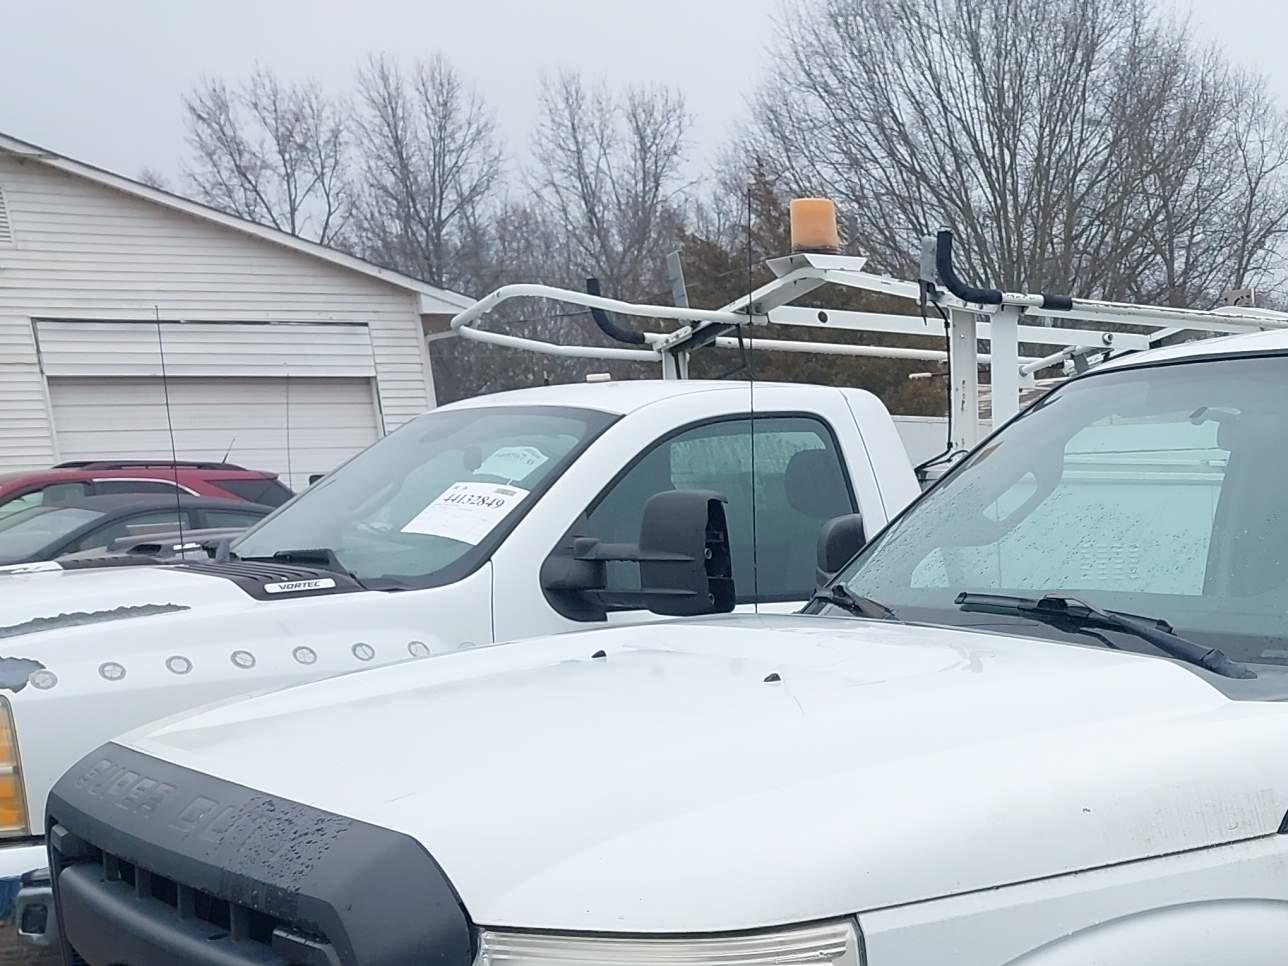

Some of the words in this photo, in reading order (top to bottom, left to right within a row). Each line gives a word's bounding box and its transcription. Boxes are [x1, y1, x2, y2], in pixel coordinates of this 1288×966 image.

[444, 493, 505, 509] 44132849
[277, 580, 321, 590] VORTEC
[75, 758, 177, 818] SUPER
